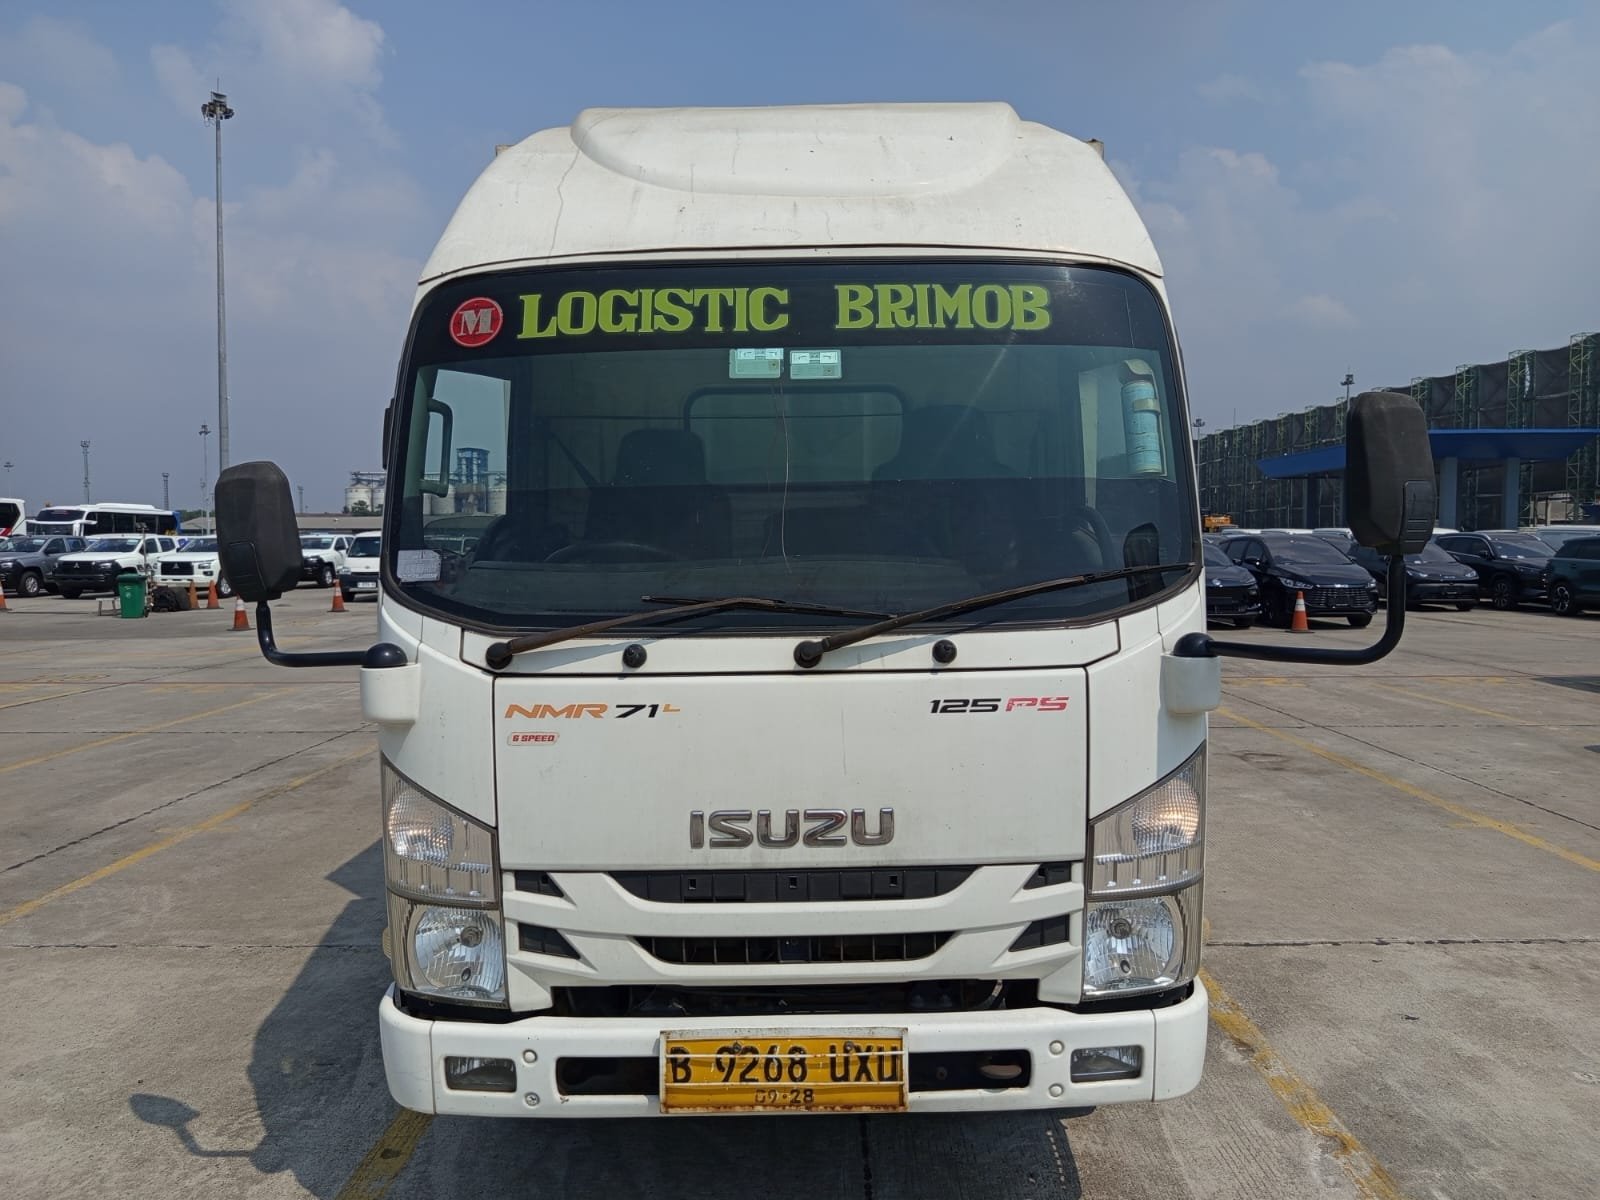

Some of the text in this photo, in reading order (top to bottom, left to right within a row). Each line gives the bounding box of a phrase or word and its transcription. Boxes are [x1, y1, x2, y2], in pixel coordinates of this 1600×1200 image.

[456, 307, 496, 337] M
[516, 284, 1052, 340] LOGISTIC BRIMOB
[504, 703, 609, 719] NMR
[930, 696, 1070, 714] 125 PS
[521, 733, 556, 743] SPEED
[690, 807, 895, 849] ISUZU
[669, 1043, 899, 1084] B 9268 UXU
